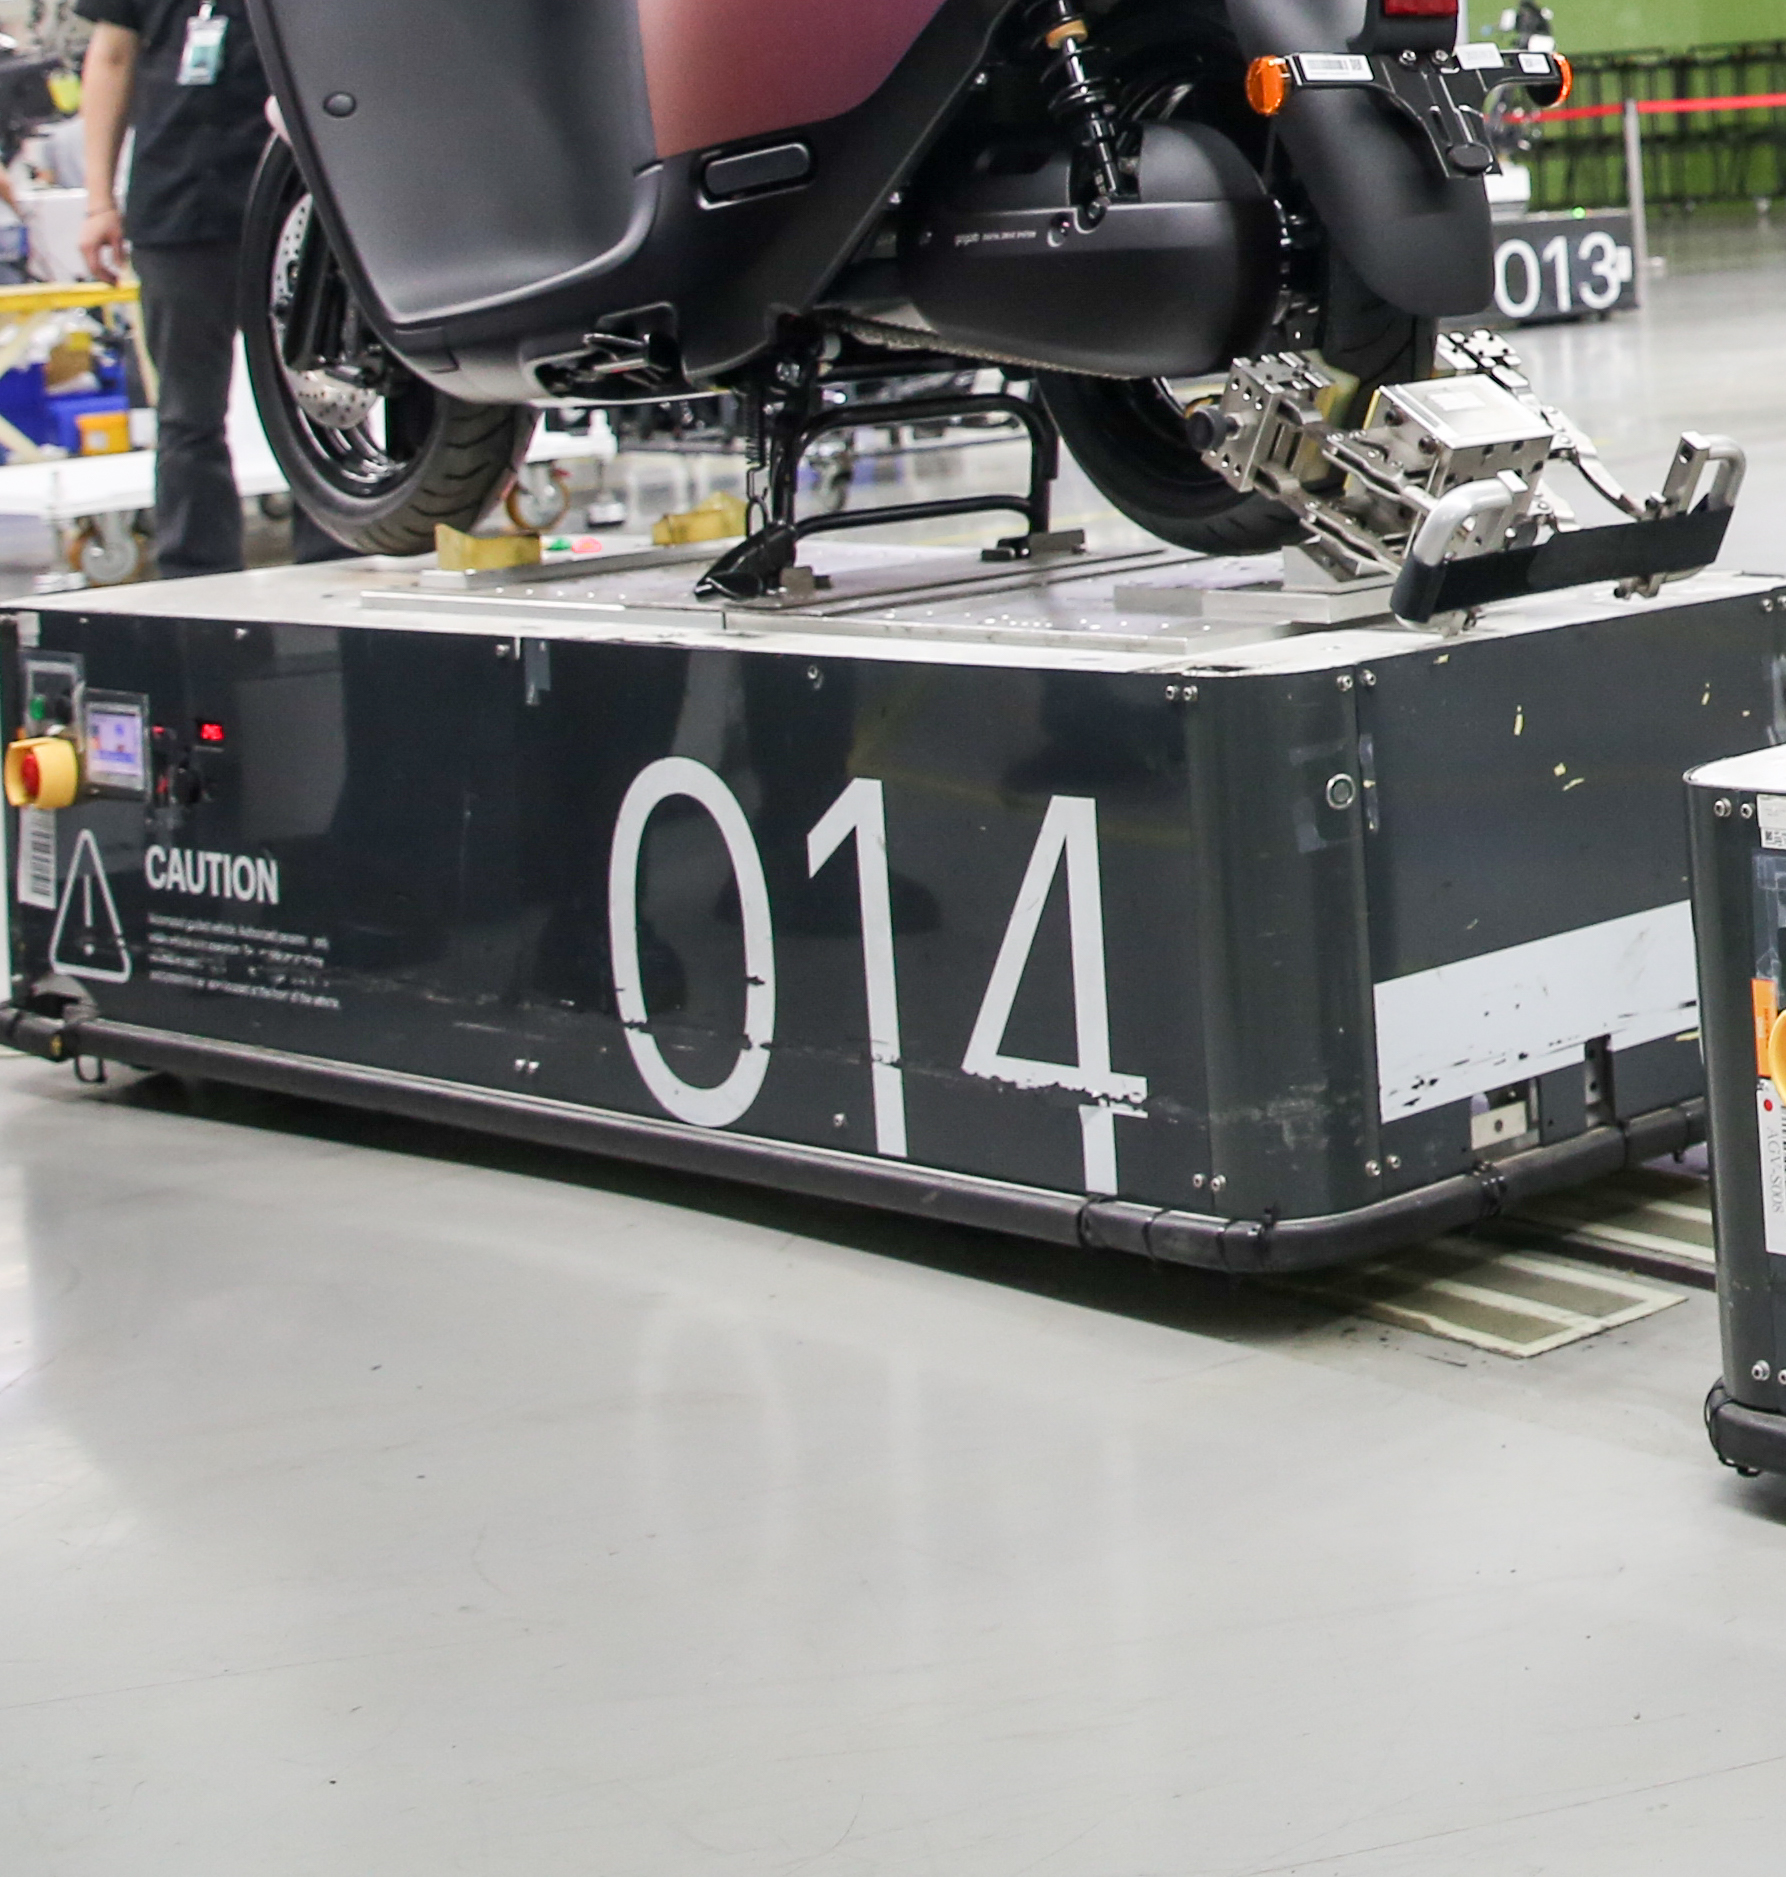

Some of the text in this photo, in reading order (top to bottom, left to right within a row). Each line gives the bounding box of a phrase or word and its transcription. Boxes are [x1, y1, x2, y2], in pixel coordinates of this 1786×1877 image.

[1494, 231, 1622, 318] 013
[145, 844, 280, 905] CAUTION
[608, 756, 1148, 1195] 014
